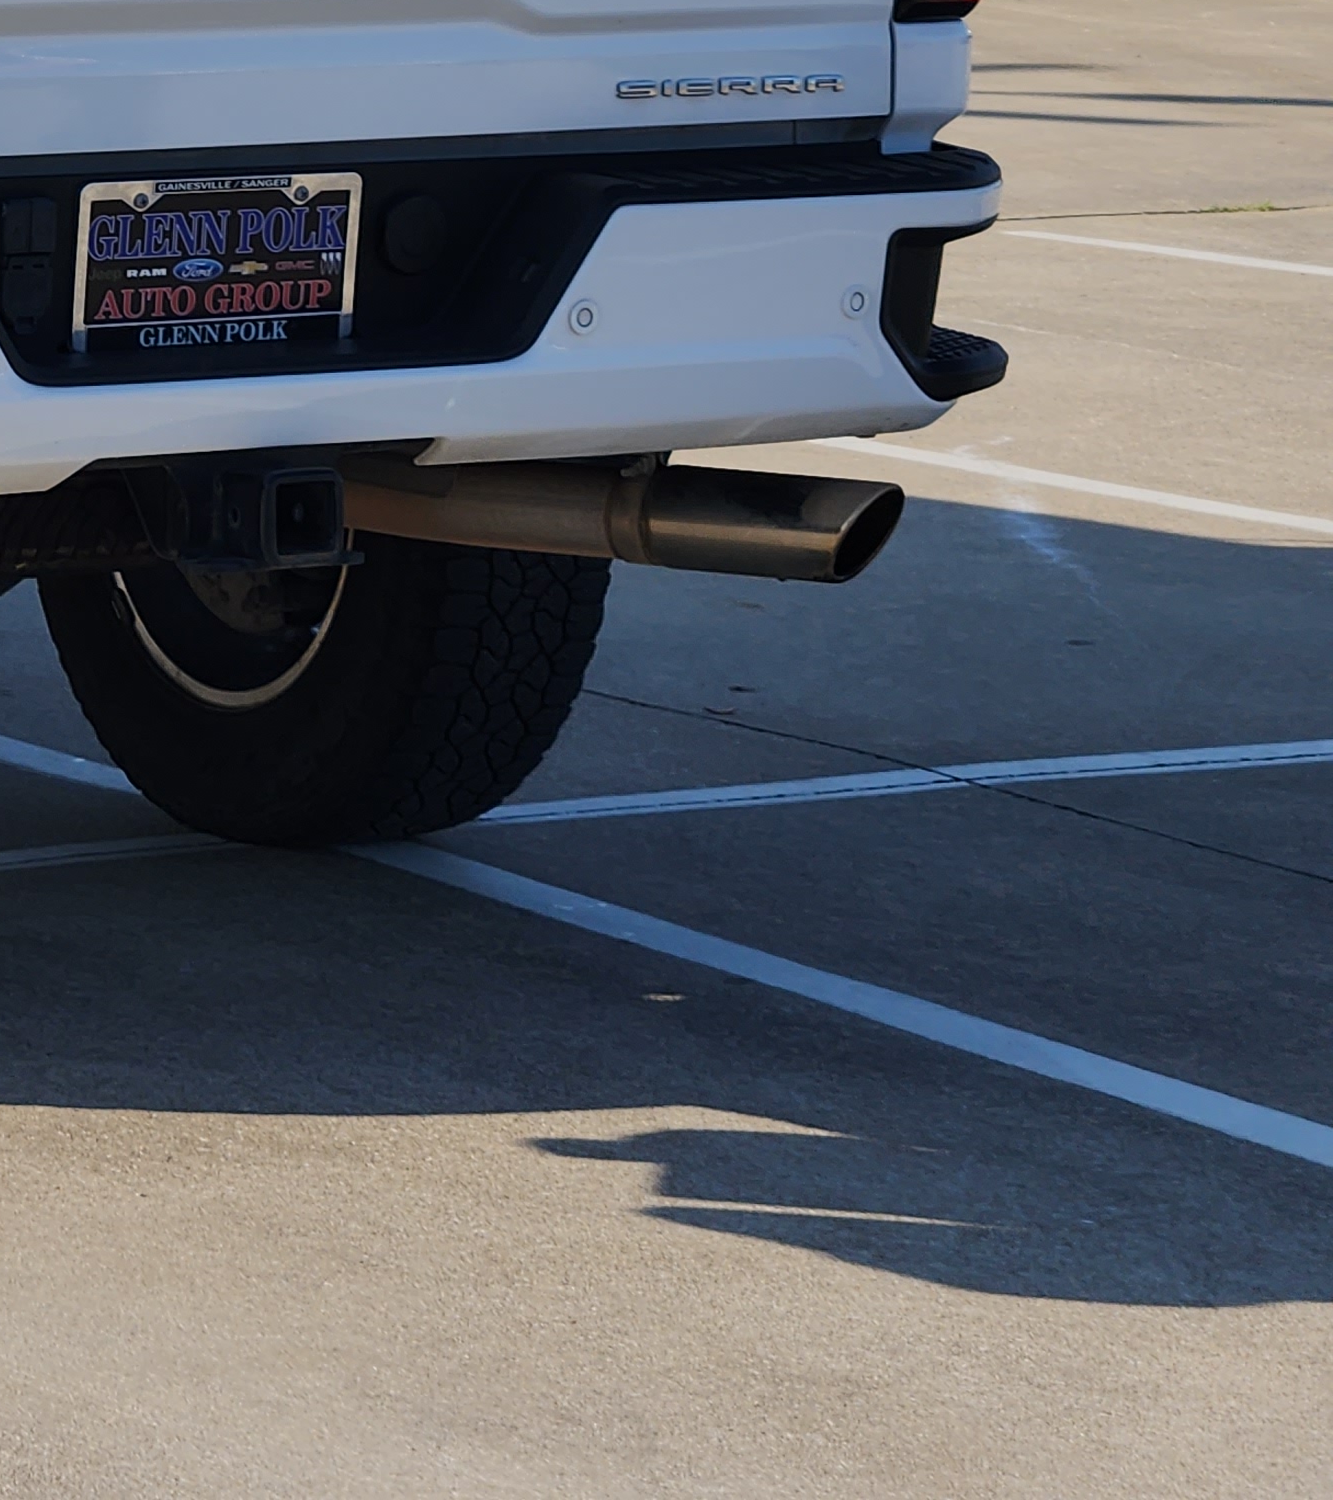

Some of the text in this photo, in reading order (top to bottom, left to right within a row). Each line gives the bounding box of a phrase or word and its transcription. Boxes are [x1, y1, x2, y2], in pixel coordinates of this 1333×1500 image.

[616, 73, 846, 100] SIERRA
[88, 205, 347, 261] GLENN POLK
[127, 268, 167, 278] RAM
[275, 260, 315, 271] GMC
[94, 280, 331, 319] AUTO GROUP
[139, 320, 288, 347] GLENN POLK
